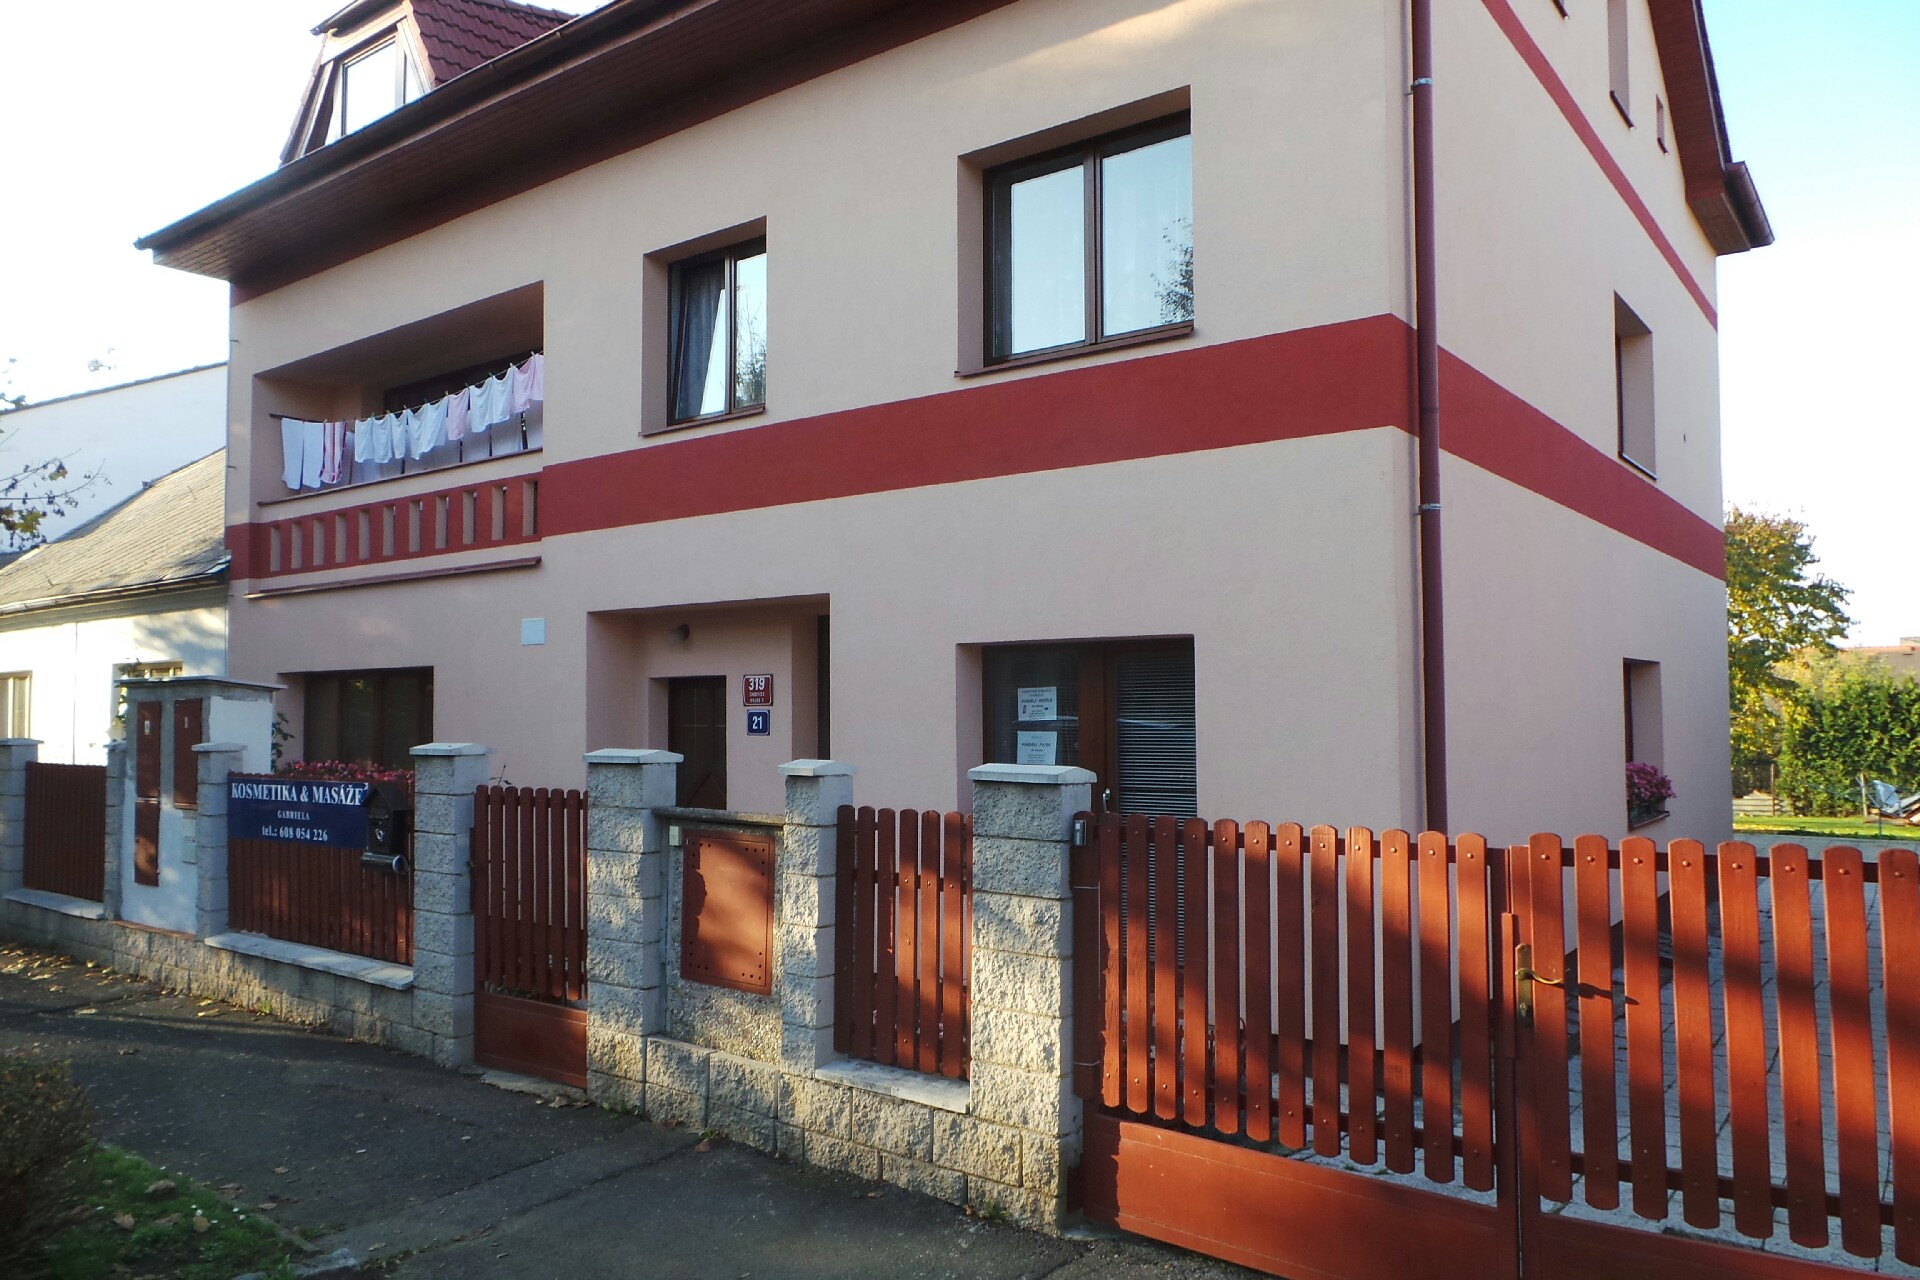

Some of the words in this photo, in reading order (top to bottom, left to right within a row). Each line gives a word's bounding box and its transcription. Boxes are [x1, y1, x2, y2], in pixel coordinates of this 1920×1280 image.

[748, 677, 765, 691] 319
[752, 715, 763, 730] 21
[231, 783, 297, 802] KOSMETIKA
[300, 785, 309, 802] &
[312, 784, 364, 806] MASÁŽE
[277, 810, 310, 821] GABRIELA
[279, 826, 294, 839] 608
[296, 828, 311, 840] 054
[313, 829, 328, 842] 226
